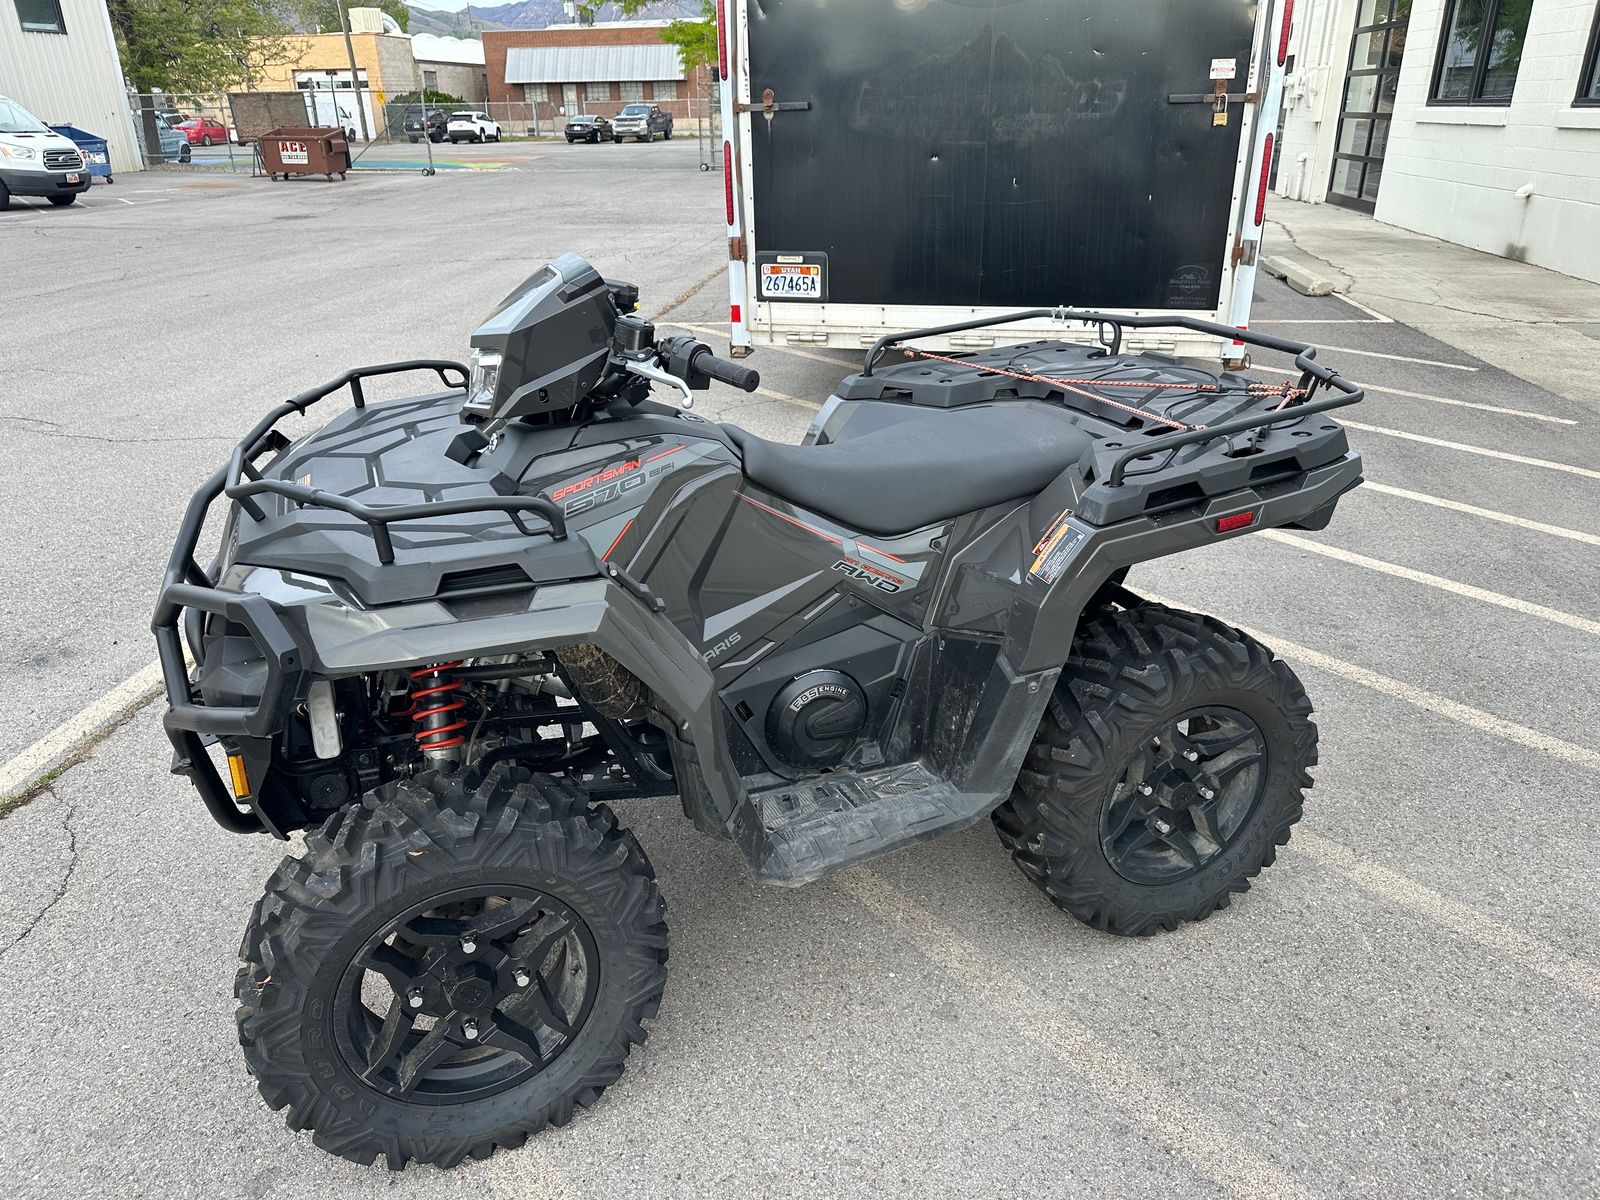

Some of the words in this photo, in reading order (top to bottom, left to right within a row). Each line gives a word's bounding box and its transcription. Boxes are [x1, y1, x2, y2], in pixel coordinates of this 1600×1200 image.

[281, 142, 306, 152] ACE
[766, 276, 816, 292] 267465A
[552, 458, 641, 502] SPORTSMAN
[564, 470, 647, 518] 570
[650, 462, 675, 477] EFI
[831, 560, 902, 594] AWD
[703, 631, 742, 663] ARIS
[792, 688, 818, 710] EBS
[818, 685, 849, 696] ENGINE
[307, 998, 356, 1101] DURO
